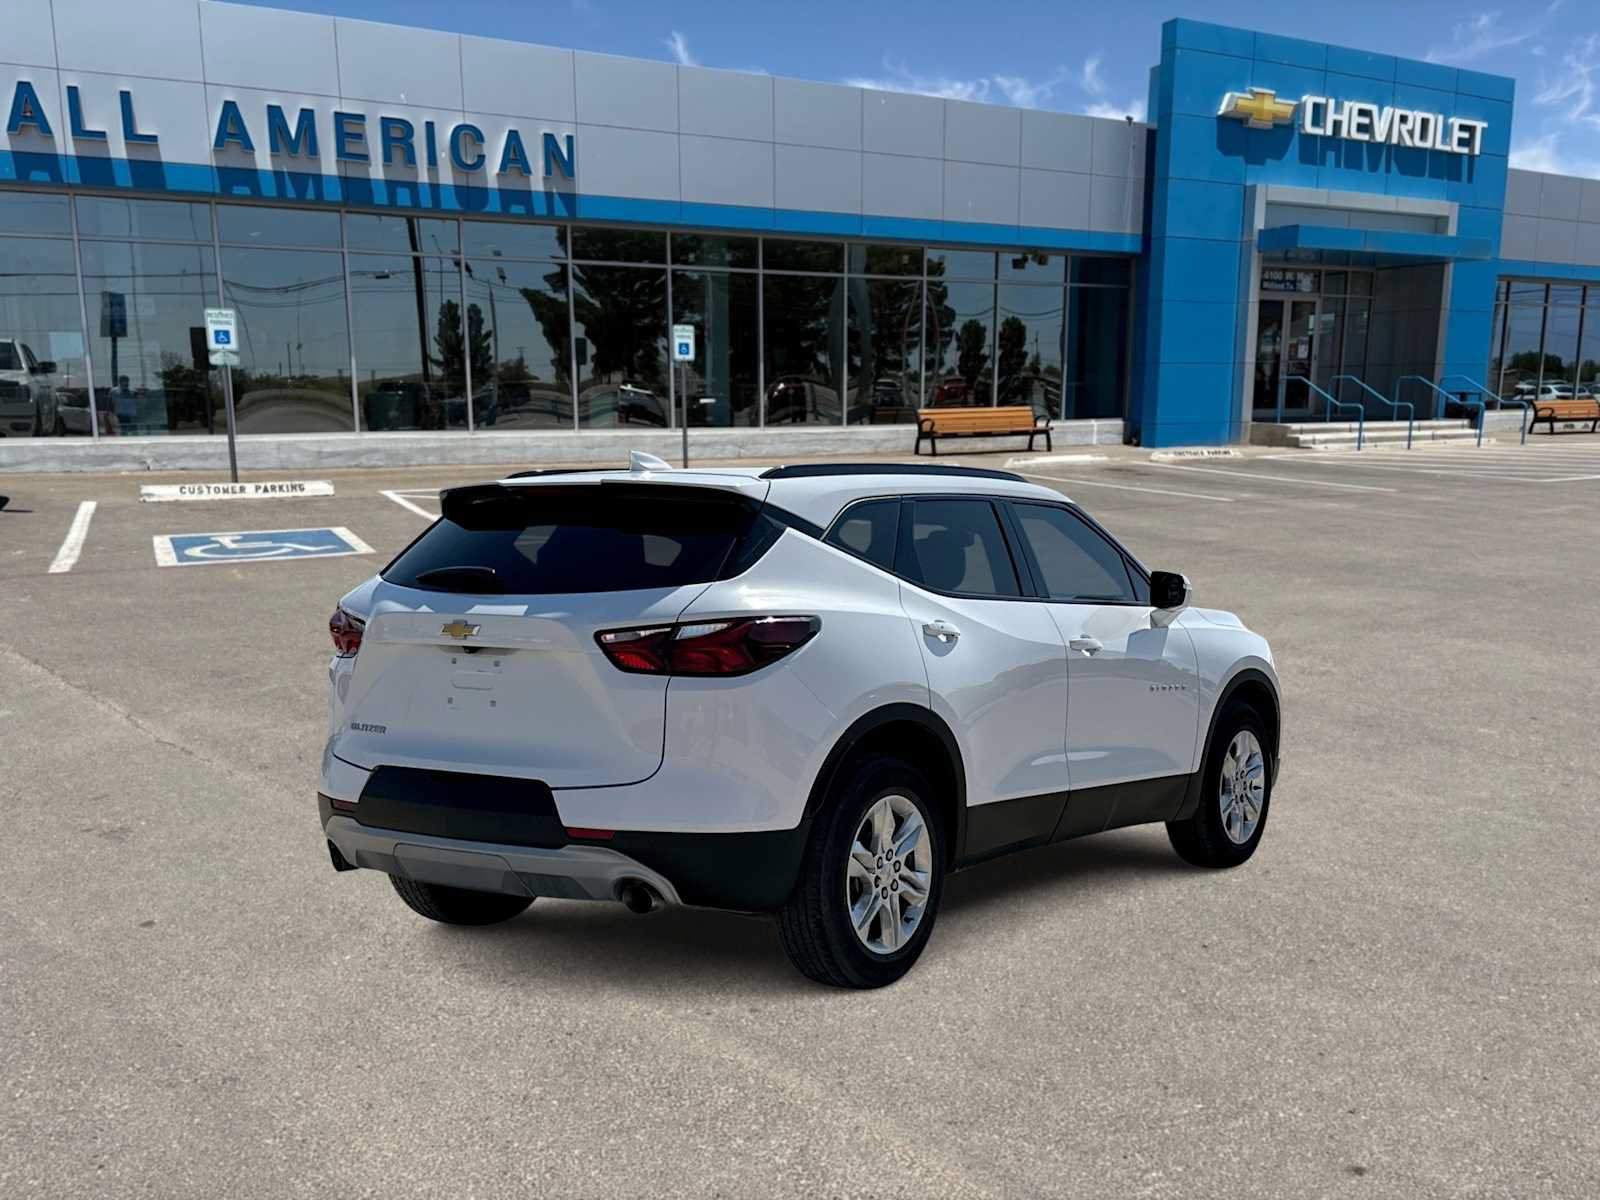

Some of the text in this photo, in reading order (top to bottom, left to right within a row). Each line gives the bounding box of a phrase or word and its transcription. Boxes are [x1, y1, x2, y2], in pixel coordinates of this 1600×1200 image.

[6, 80, 576, 179] ALL AMERICAN
[1301, 94, 1488, 155] CHEVROLET
[179, 483, 306, 495] CUSTOMER PARKING
